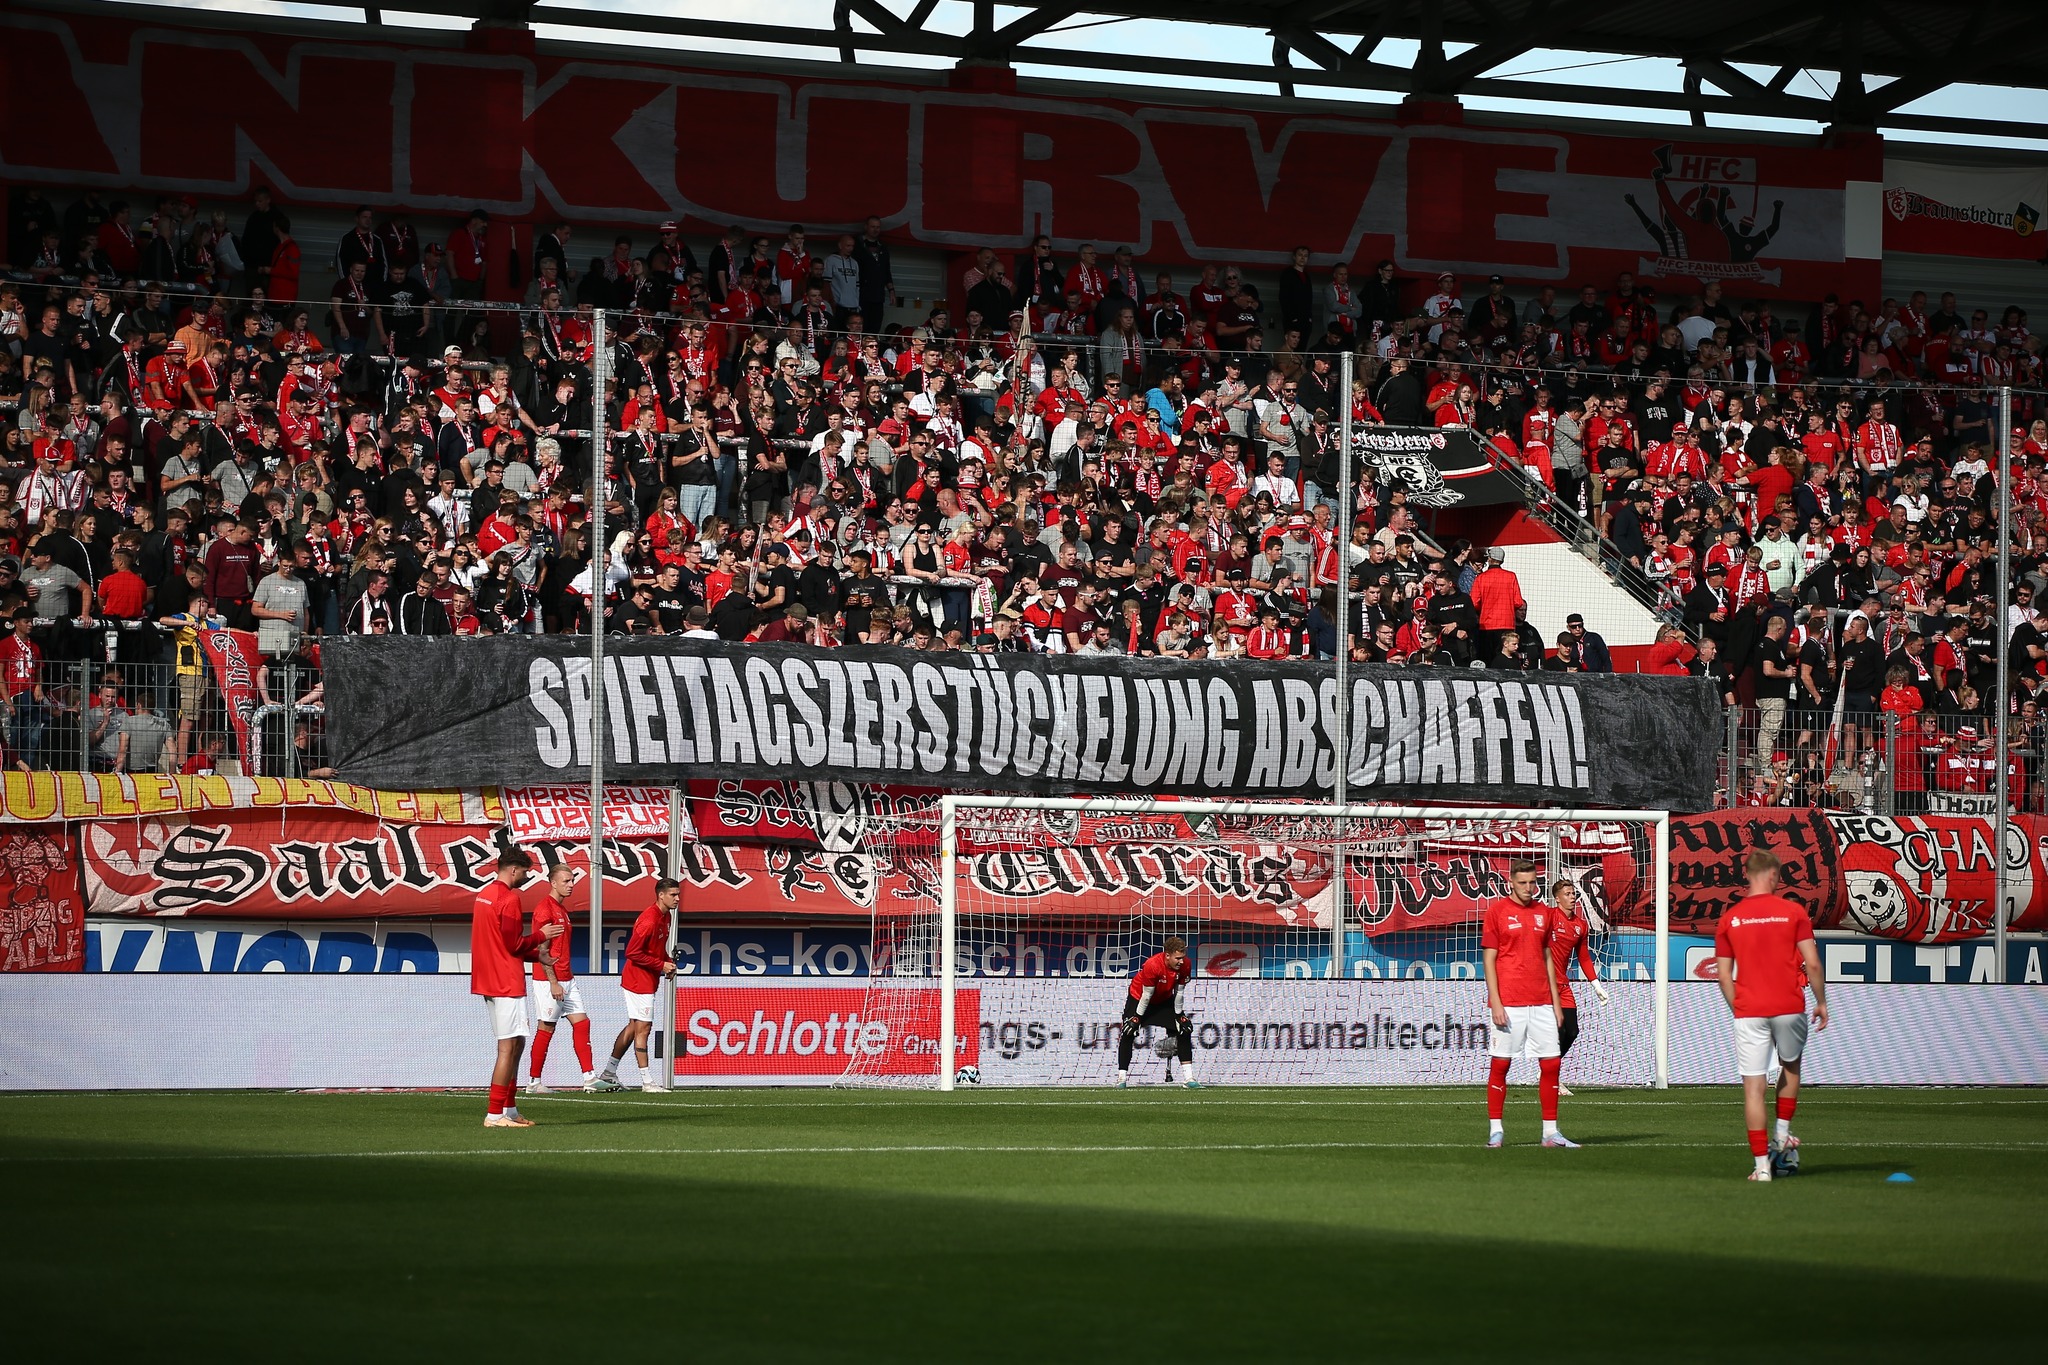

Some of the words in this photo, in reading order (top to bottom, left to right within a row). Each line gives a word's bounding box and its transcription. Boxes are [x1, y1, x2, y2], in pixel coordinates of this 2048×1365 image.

[1680, 156, 1742, 181] HFC
[1907, 194, 2013, 227] Braunsbedra
[1657, 258, 1761, 273] HFC-FANKURVE
[1351, 429, 1432, 451] etersberg
[1388, 456, 1415, 465] HFC
[529, 654, 1240, 788] SPIELTAGSZERSTÜCKELUNG
[1246, 677, 1590, 789] ABSCHAFFEN!
[0, 771, 234, 820] ULLEN
[503, 786, 671, 809] MERSBUR
[509, 806, 671, 834] QUEFUR
[1095, 819, 1177, 842] SÜDHARZ
[1833, 816, 1892, 846] HFC
[1357, 852, 1548, 925] Köth
[1741, 916, 1789, 925] Saalesparkasse
[686, 1009, 889, 1057] Schlotte
[903, 1034, 968, 1054] GmH
[1188, 1013, 1489, 1050] ommunaltechn
